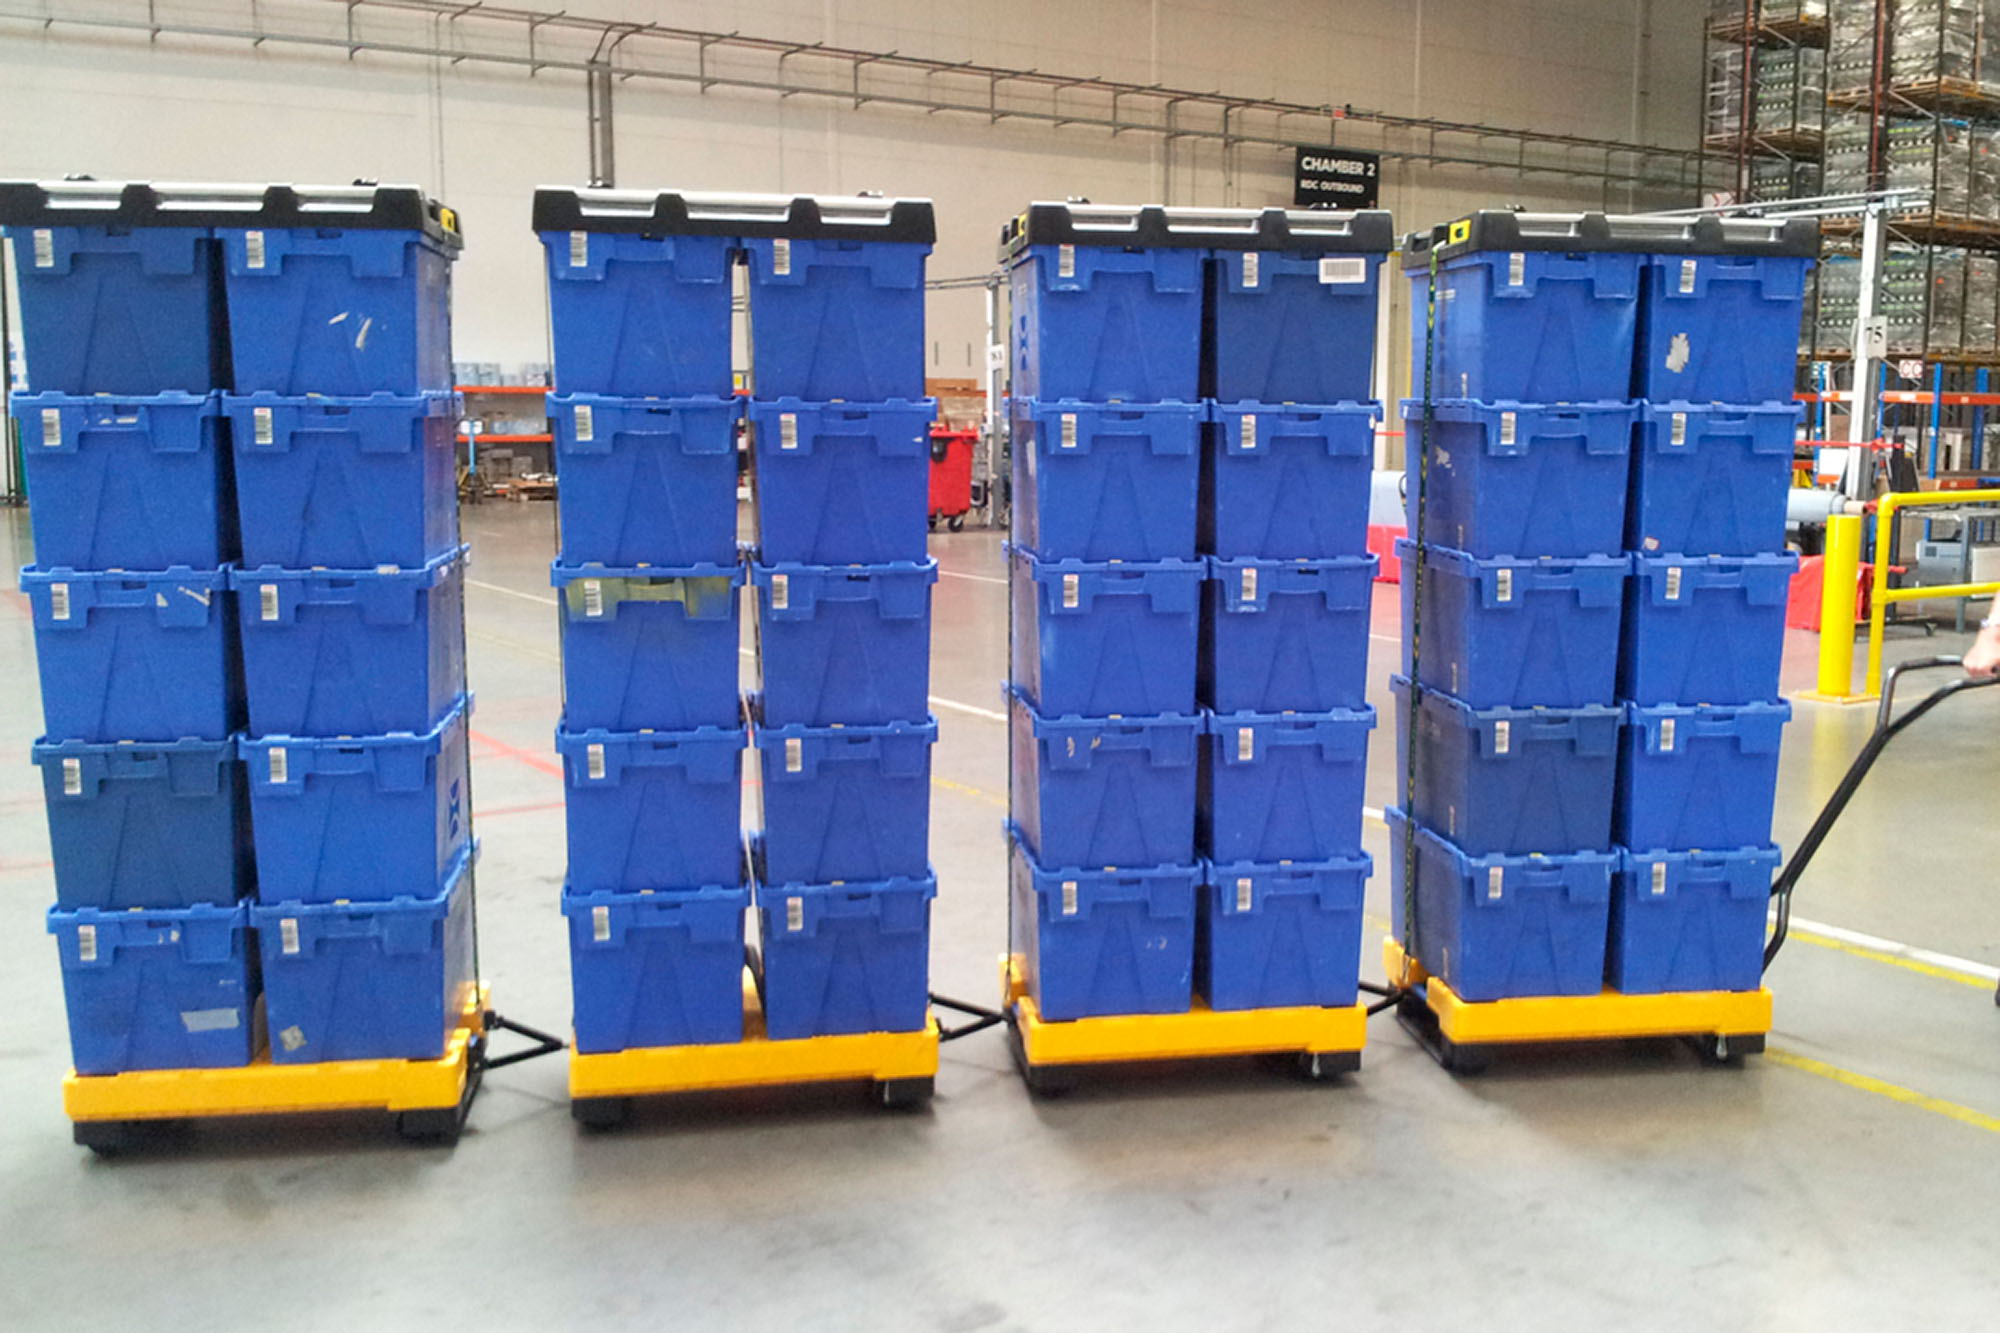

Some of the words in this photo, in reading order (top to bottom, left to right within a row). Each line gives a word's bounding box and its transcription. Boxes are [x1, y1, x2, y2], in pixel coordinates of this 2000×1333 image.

[1301, 156, 1364, 175] CHAMBER
[1366, 163, 1375, 177] 2
[1320, 181, 1364, 193] OUTBOUND
[1865, 326, 1884, 343] 75
